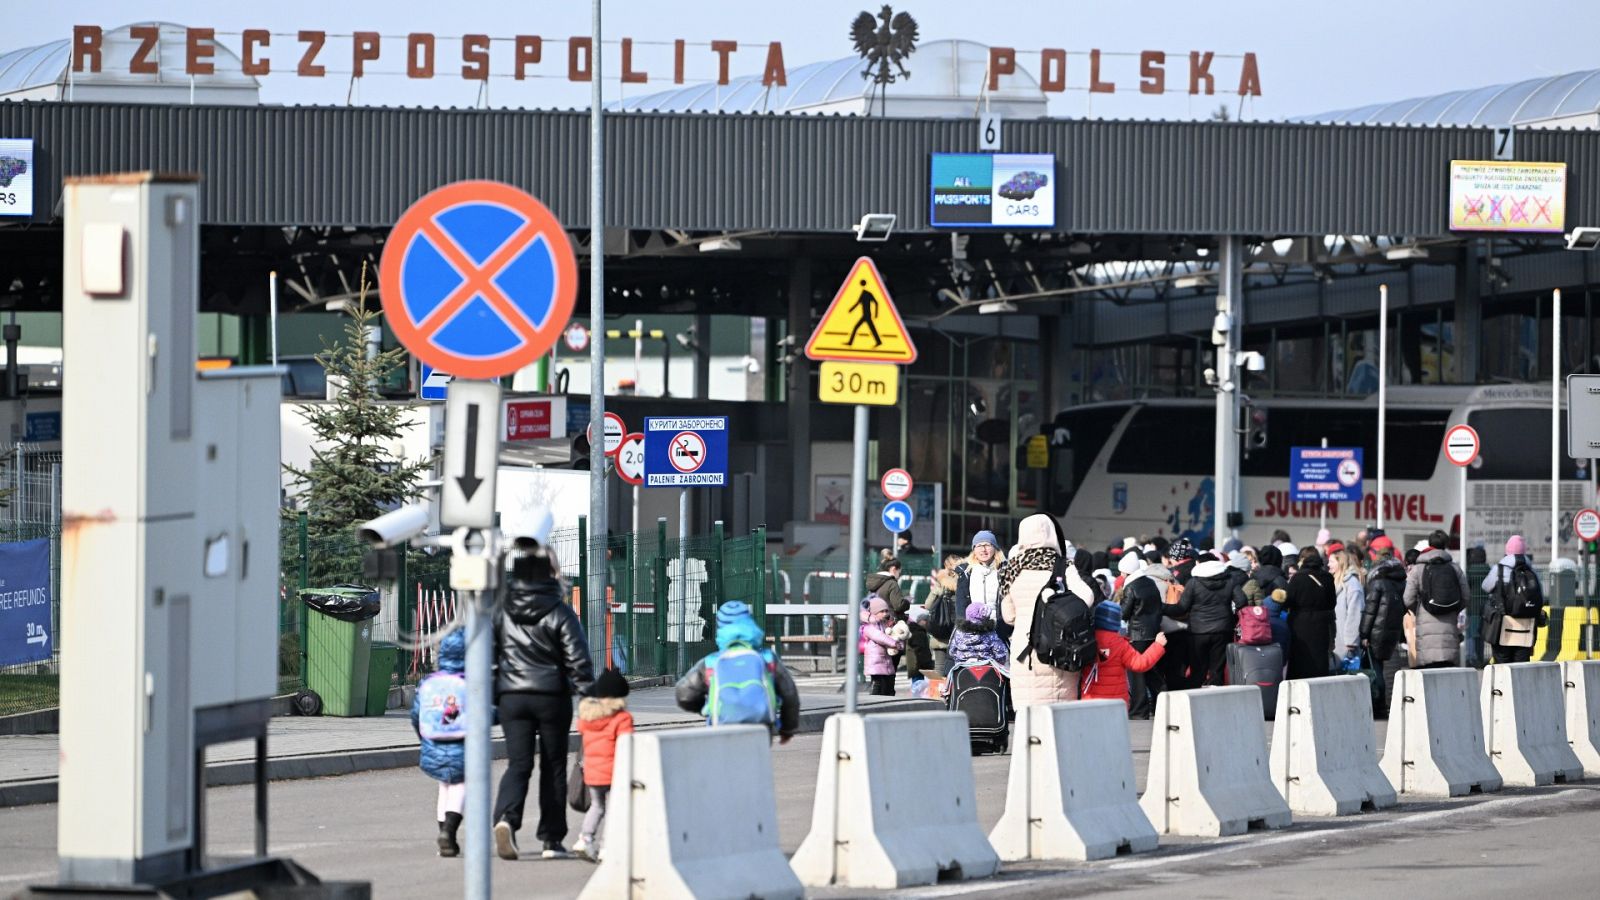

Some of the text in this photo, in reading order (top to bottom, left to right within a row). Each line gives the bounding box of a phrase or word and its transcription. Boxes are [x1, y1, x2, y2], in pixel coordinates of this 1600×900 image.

[73, 25, 1262, 96] RZECZPOSPOLITA POLSKA
[985, 118, 996, 144] 6
[1497, 128, 1511, 156] 7
[953, 177, 971, 187] ALL
[934, 194, 991, 205] PASSPORTS
[1006, 205, 1039, 216] CARS
[1483, 389, 1553, 398] Mercedes-Ben
[650, 420, 724, 430] КУРИТИ ЗАБОРОНЕНО
[650, 473, 722, 484] PALENIE ZABRONIONE
[13, 587, 46, 608] REFUNDS
[27, 622, 35, 637] 30
